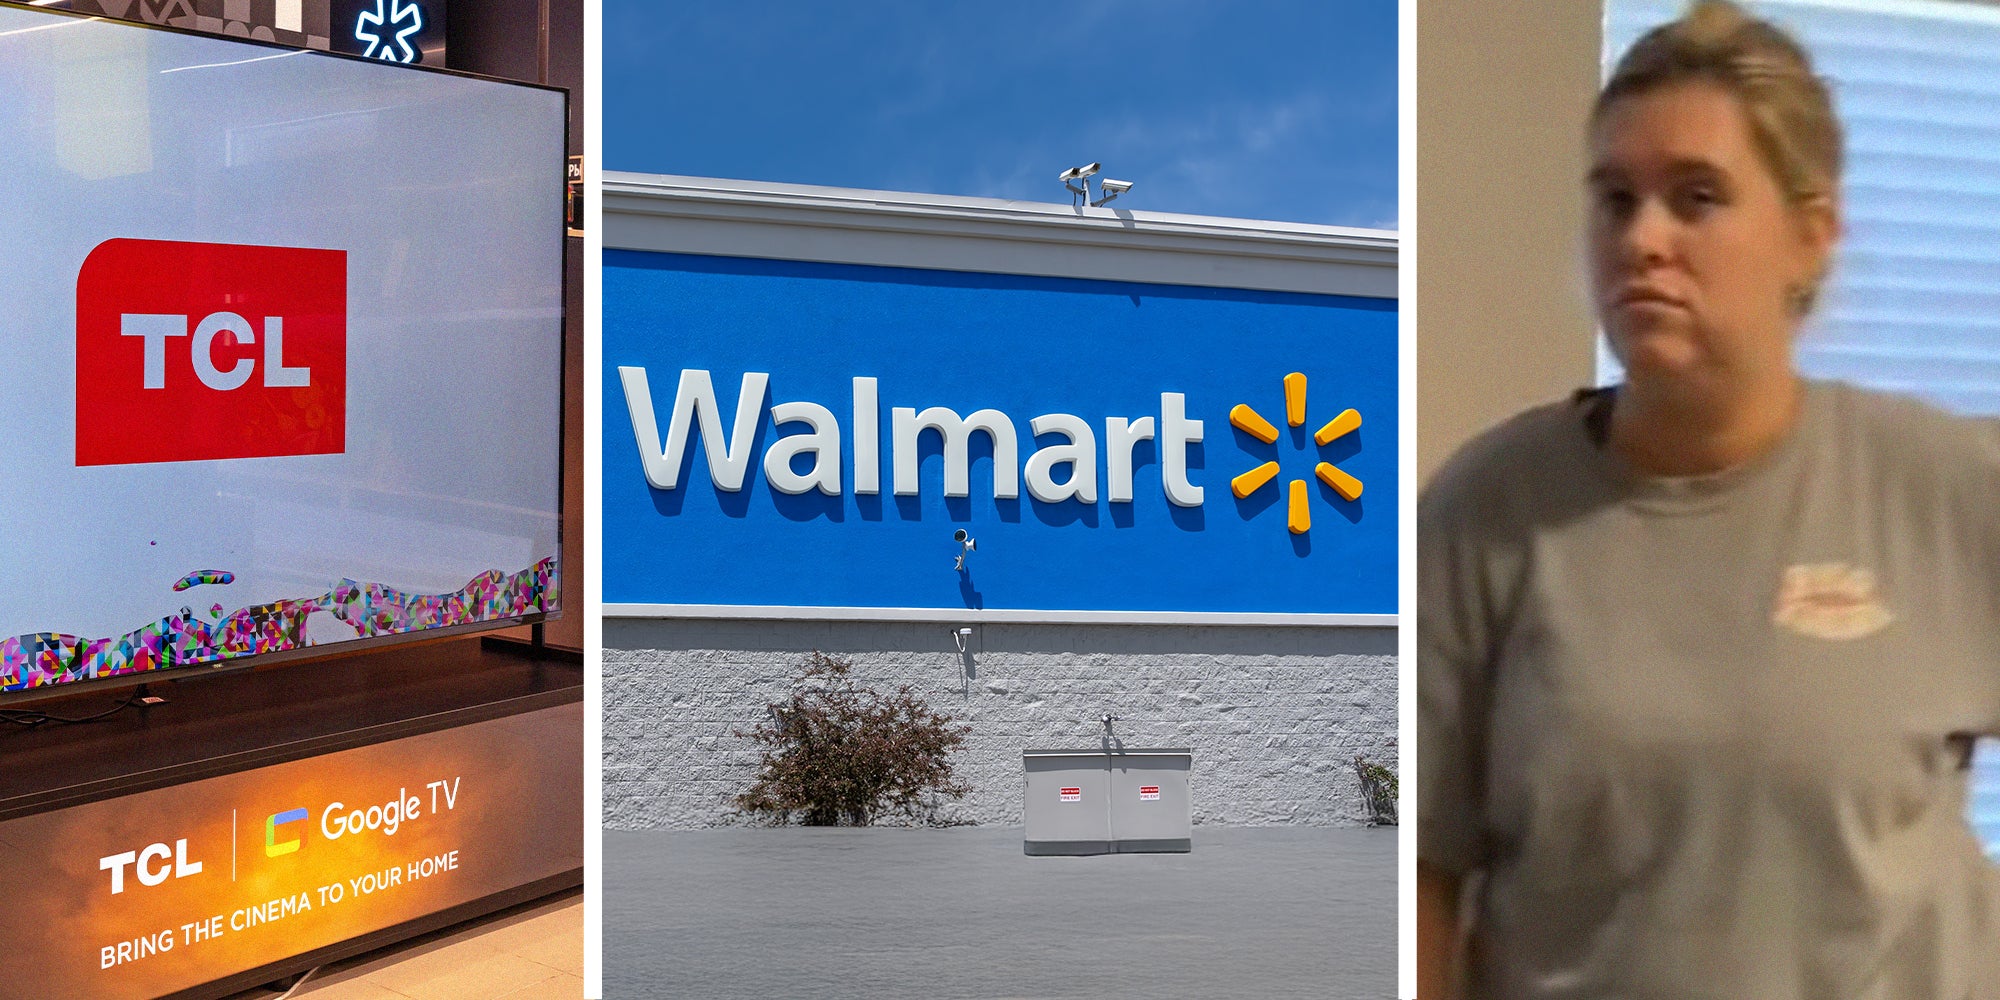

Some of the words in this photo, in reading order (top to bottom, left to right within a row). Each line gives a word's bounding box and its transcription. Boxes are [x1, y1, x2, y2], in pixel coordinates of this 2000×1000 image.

[121, 311, 310, 391] TCL
[618, 366, 1204, 507] Walmart
[321, 787, 420, 840] Google
[427, 777, 461, 814] TV
[100, 838, 202, 895] TCL
[101, 930, 174, 969] BRING
[181, 915, 224, 946] THE
[230, 892, 312, 931] CINEMA
[317, 879, 344, 907] TO
[349, 866, 402, 898] YOUR
[407, 850, 459, 883] HOME
